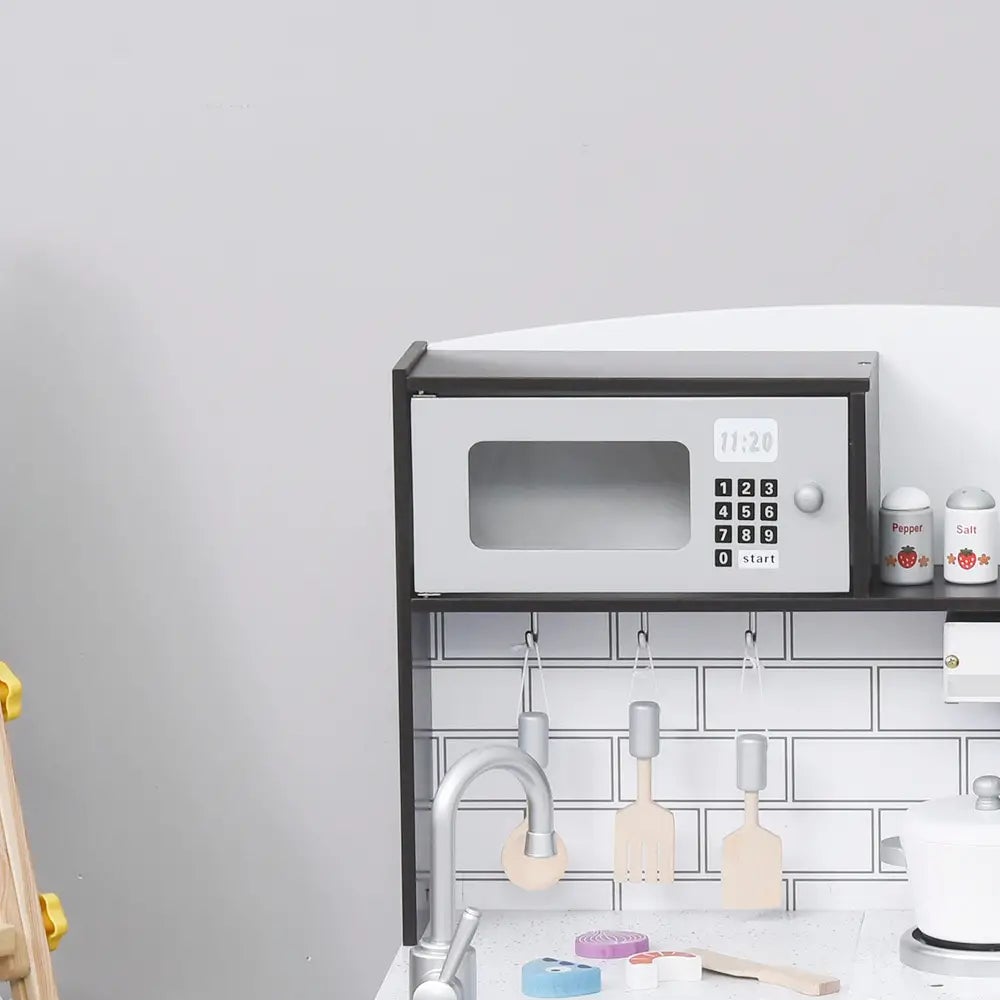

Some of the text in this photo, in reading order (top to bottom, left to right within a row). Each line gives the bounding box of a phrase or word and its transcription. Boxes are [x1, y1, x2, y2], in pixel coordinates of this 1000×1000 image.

[721, 431, 773, 453] 11:20
[719, 481, 774, 495] 1 2 3
[718, 505, 774, 518] 4 5 6
[718, 528, 774, 542] 7 8 9
[892, 522, 923, 535] Pepper
[956, 524, 977, 535] Salt
[718, 552, 775, 565] 0 start
